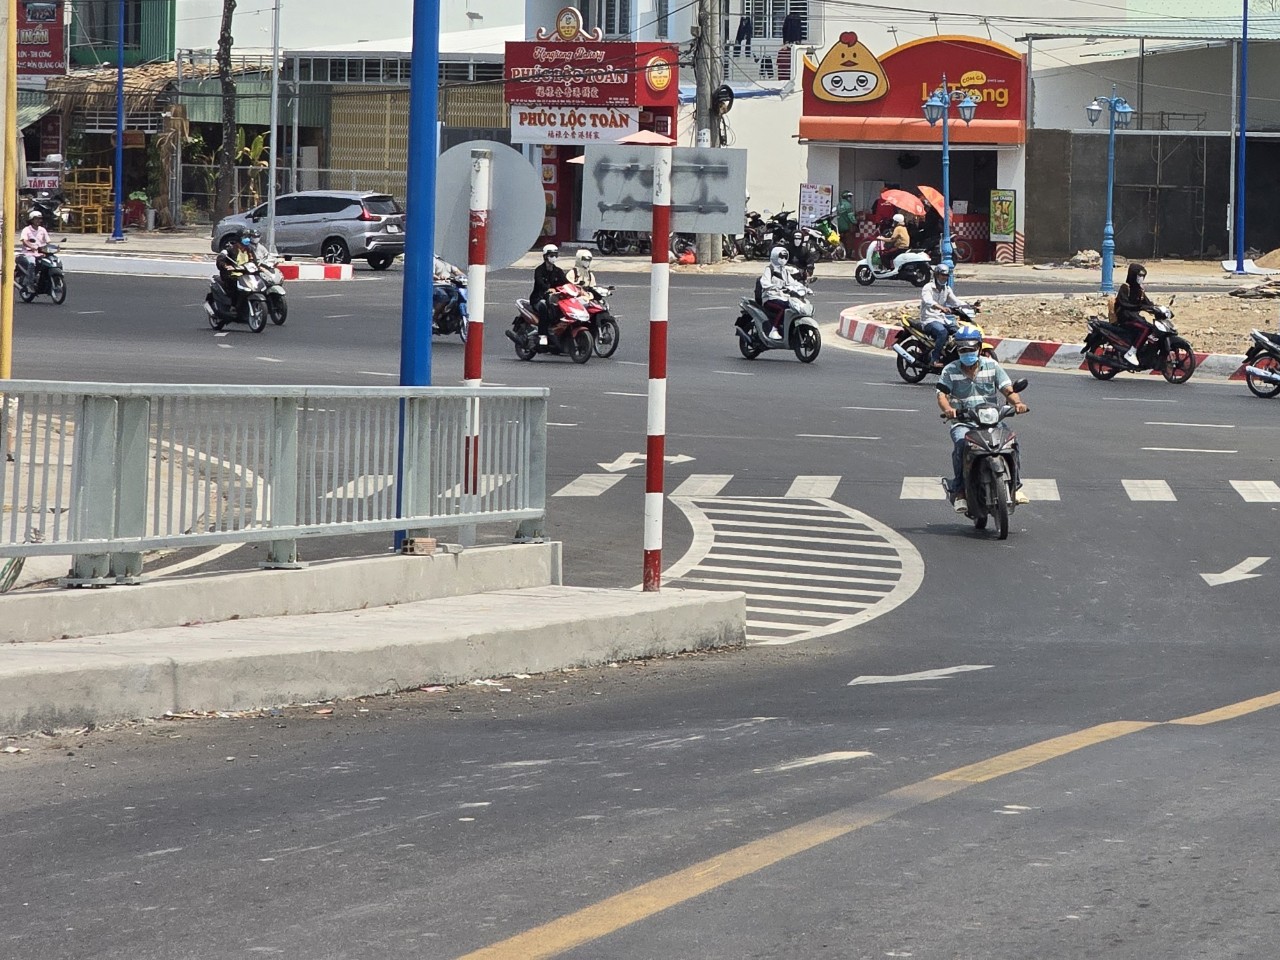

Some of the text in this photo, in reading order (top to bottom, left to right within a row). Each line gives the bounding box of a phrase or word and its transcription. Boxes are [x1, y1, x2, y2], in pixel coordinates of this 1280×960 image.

[519, 109, 630, 130] PHÚC LỘC TOÀN
